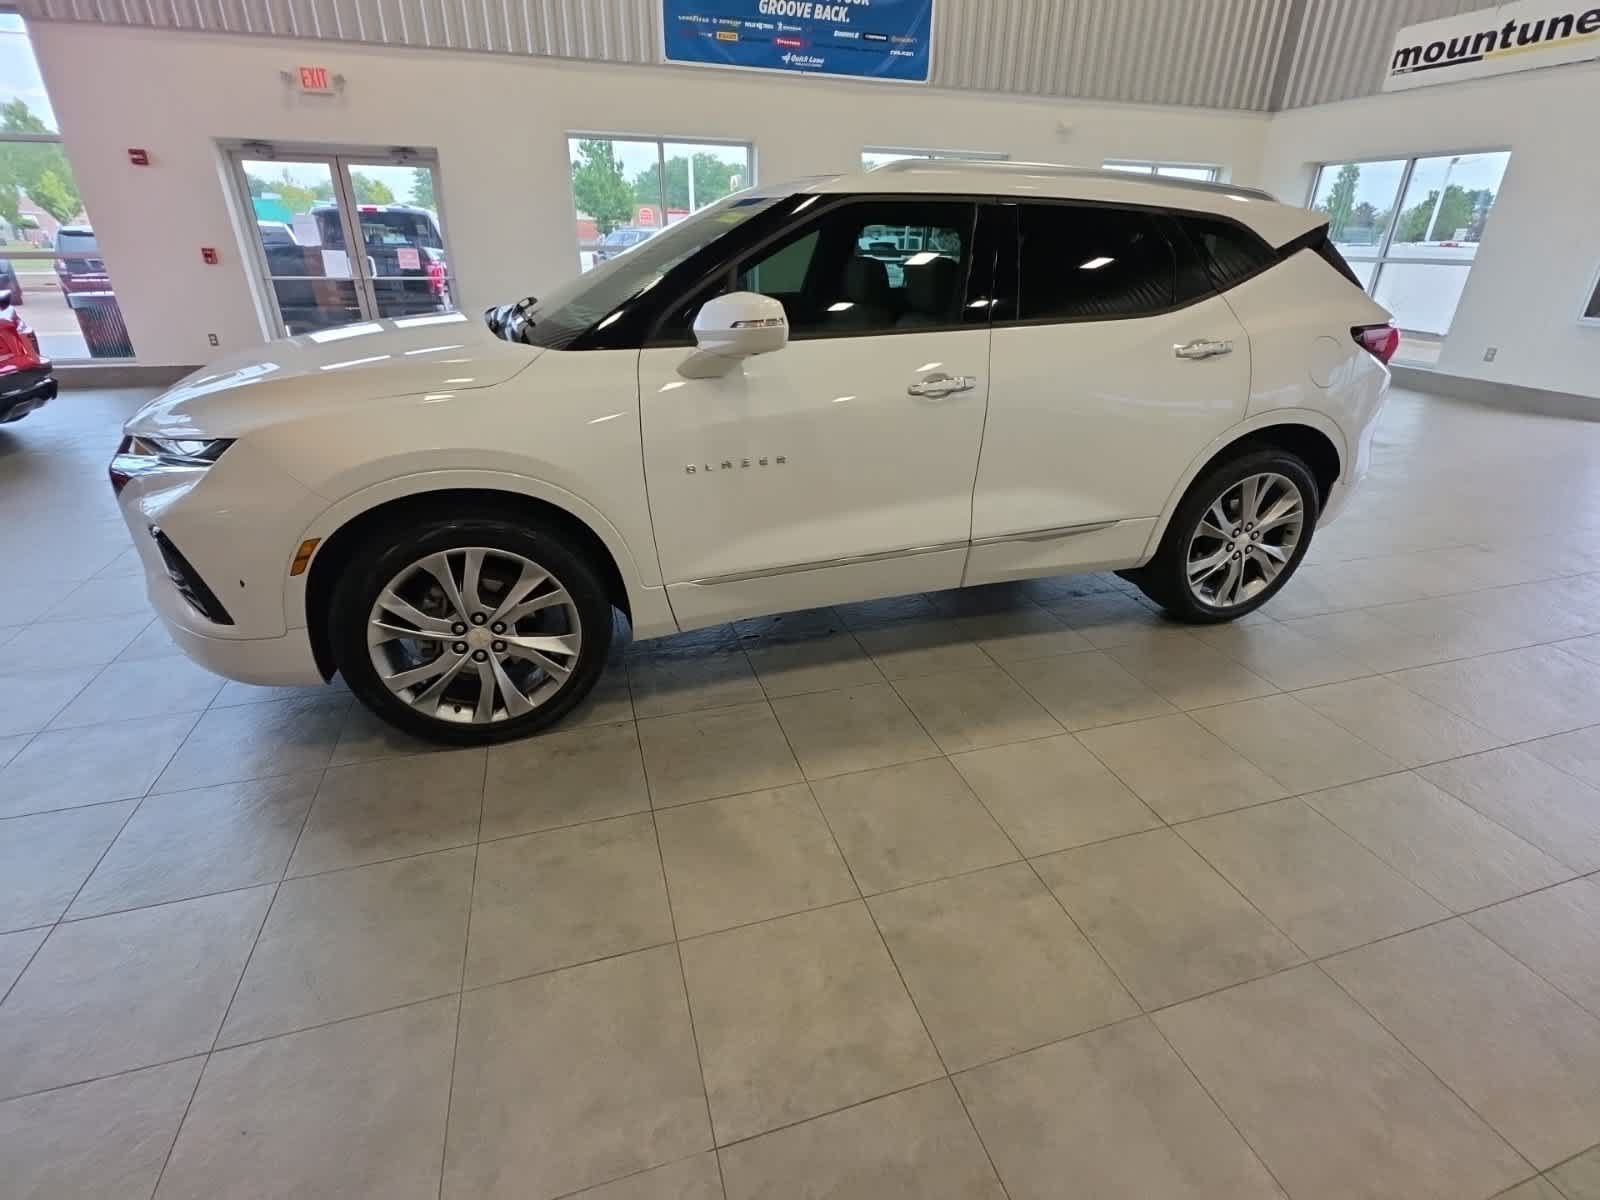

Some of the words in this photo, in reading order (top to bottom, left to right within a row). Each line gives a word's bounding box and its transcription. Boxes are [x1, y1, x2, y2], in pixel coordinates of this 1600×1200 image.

[758, 0, 813, 19] GROOVE
[813, 4, 850, 23] BACK.
[1391, 8, 1600, 70] mountune
[300, 67, 327, 89] EXIT
[685, 455, 788, 475] BLAZER
